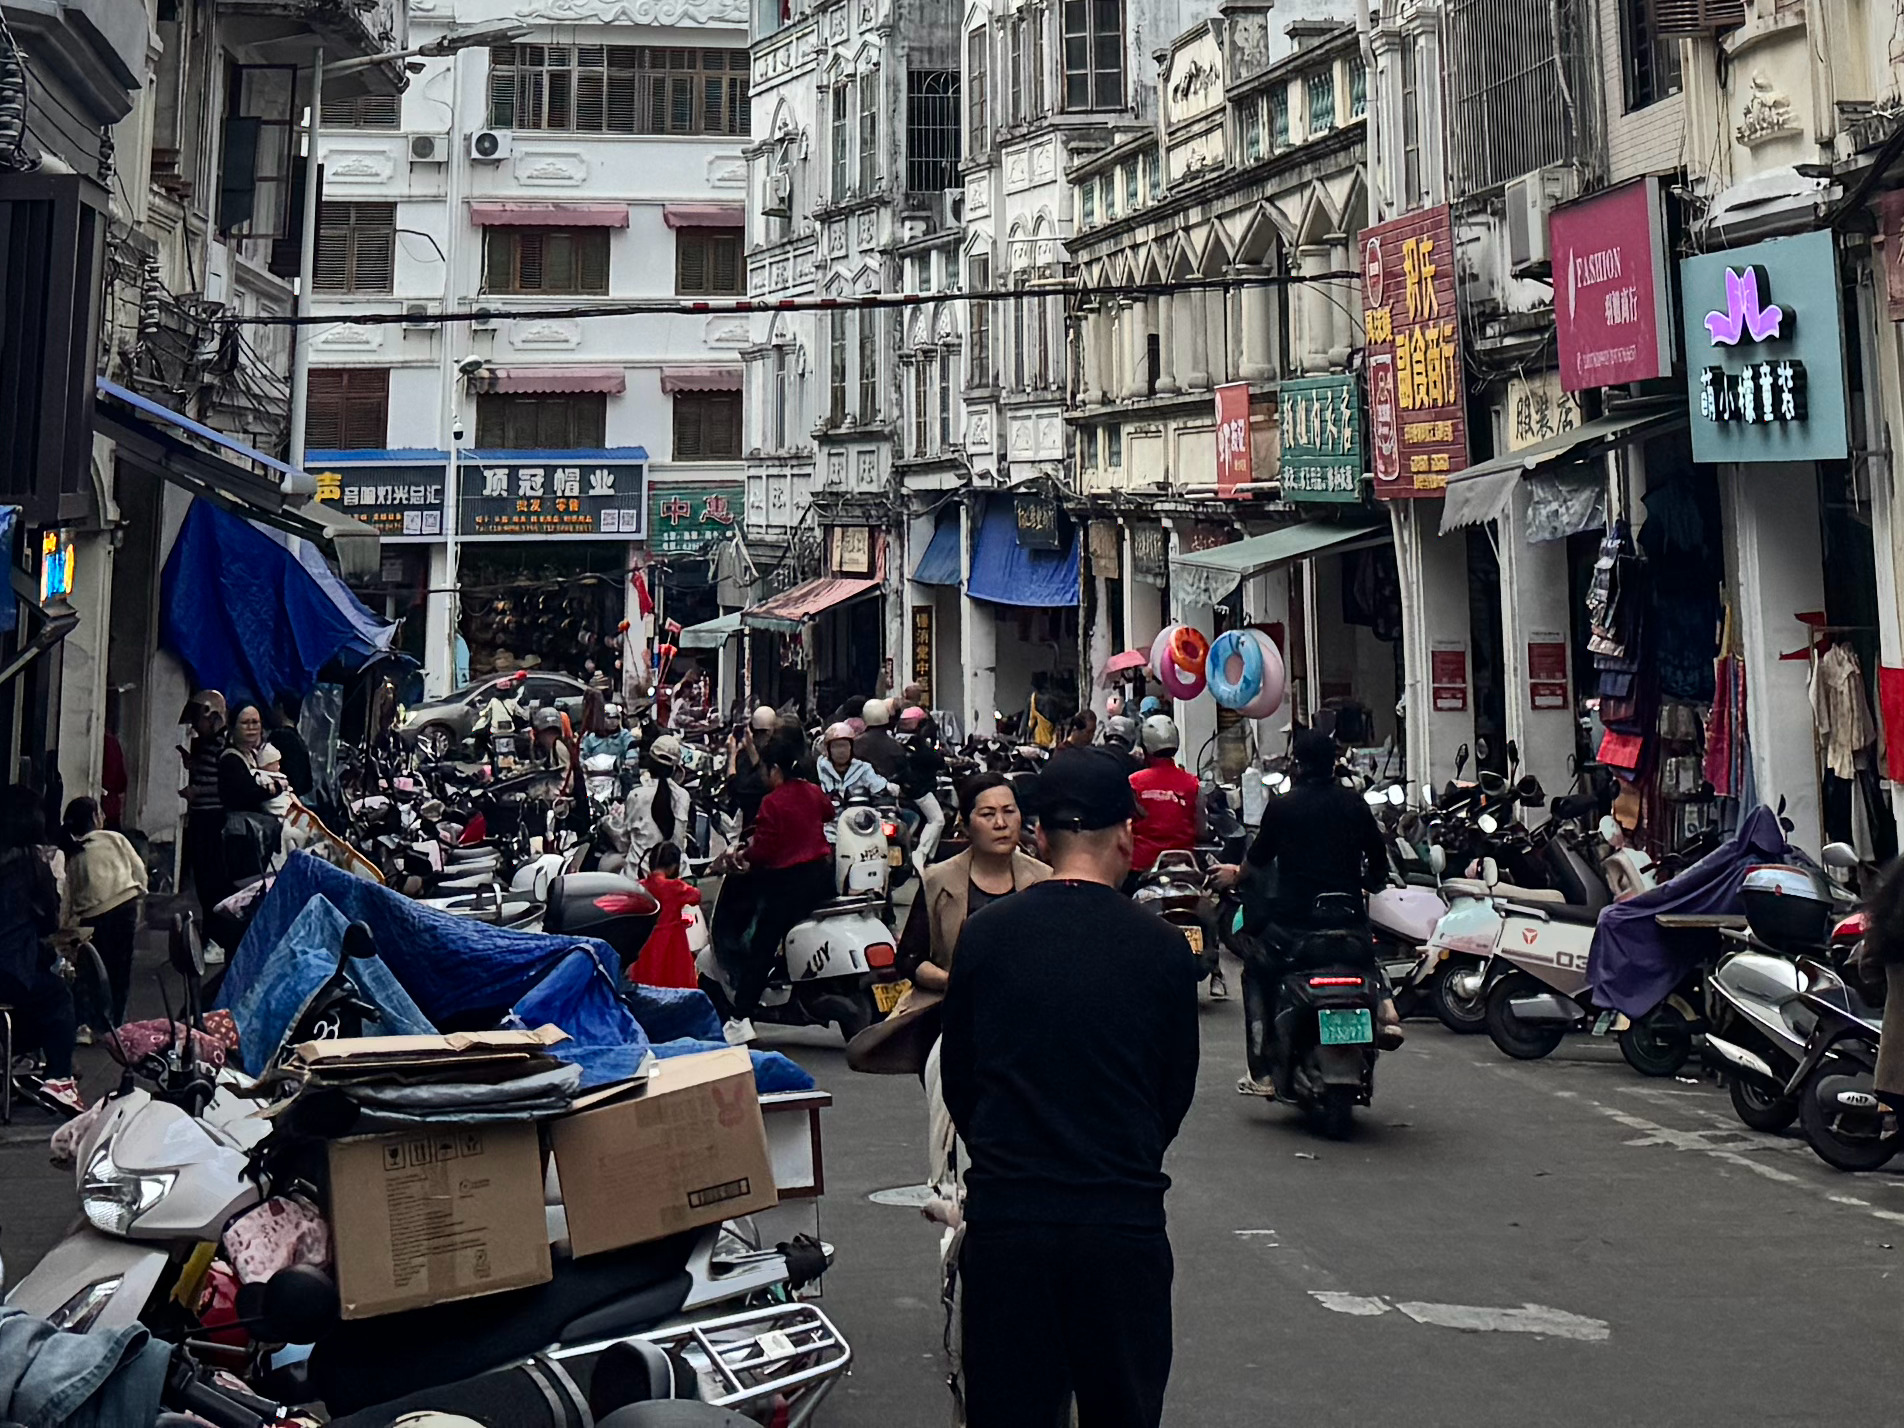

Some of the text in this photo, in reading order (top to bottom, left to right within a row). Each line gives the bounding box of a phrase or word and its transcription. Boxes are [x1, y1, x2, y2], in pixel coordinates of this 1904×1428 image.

[1576, 247, 1622, 288] FASHION
[1396, 322, 1456, 410] 副食商行
[344, 485, 441, 505] 音响灯光总汇
[482, 468, 615, 497] 顶冠帽业
